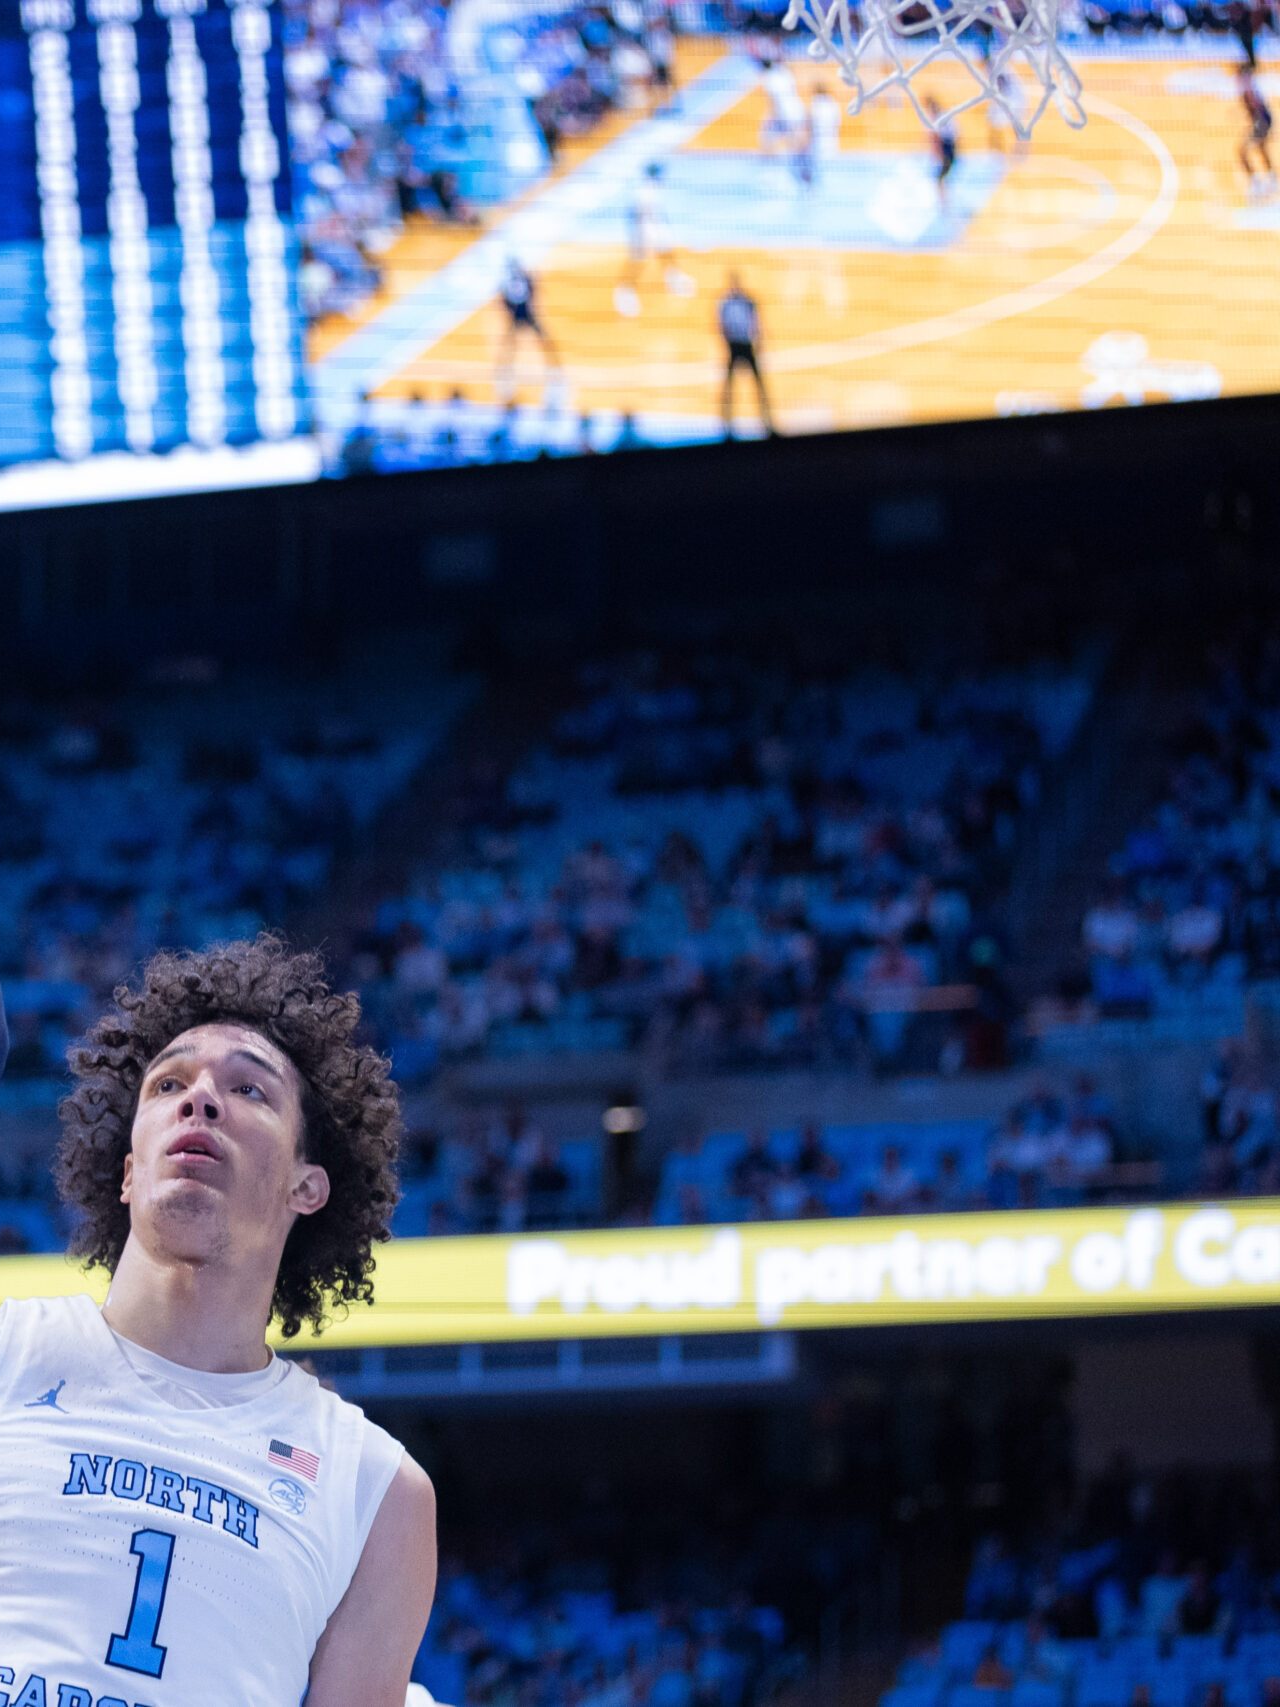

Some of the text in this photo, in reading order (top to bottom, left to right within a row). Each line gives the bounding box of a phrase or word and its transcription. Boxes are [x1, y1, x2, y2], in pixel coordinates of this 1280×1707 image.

[508, 1226, 742, 1315] Proud
[756, 1231, 1061, 1324] partner
[1071, 1207, 1164, 1291] of
[62, 1453, 260, 1549] NORTH
[104, 1527, 177, 1680] 1
